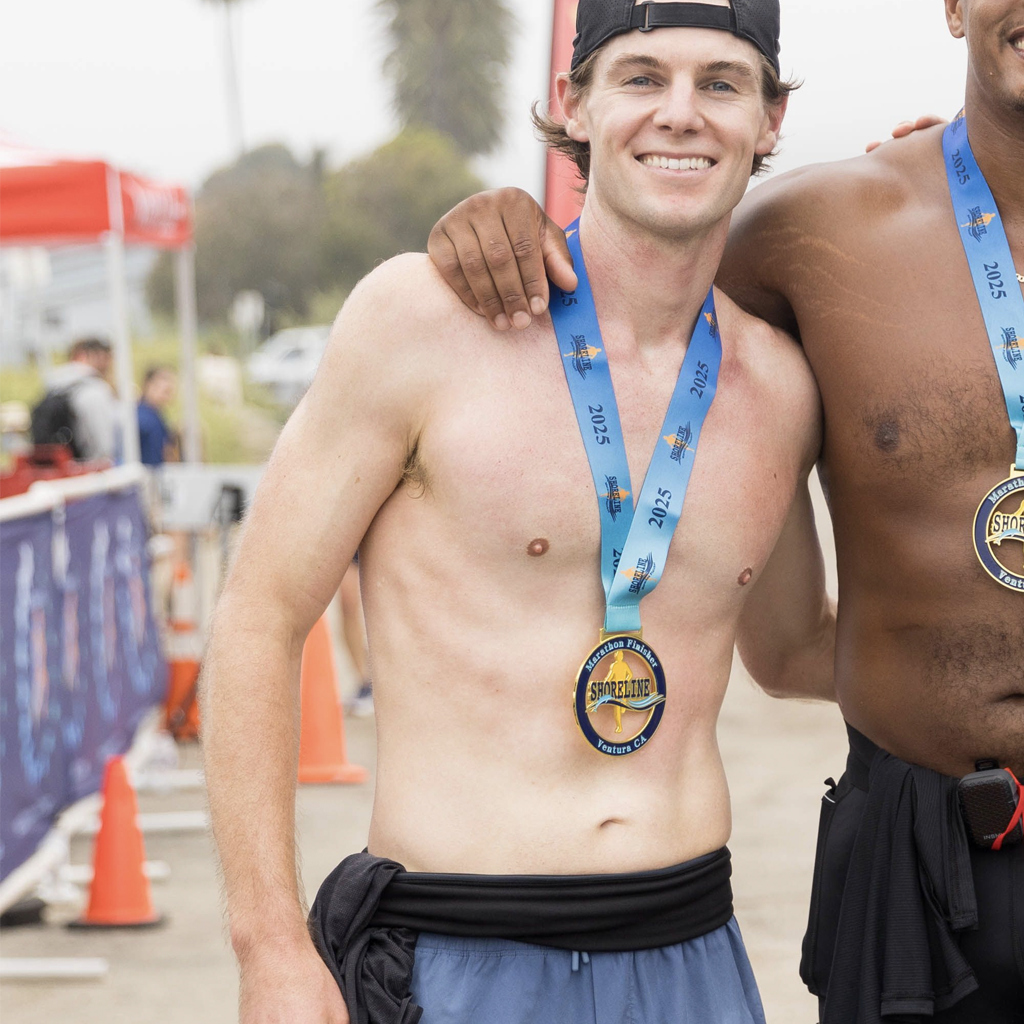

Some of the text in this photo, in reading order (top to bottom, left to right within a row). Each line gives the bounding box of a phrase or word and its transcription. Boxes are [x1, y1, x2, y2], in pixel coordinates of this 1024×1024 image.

[951, 149, 971, 185] 2025
[983, 261, 1007, 300] 2025
[689, 360, 709, 399] 2025
[587, 404, 611, 446] 2025
[648, 487, 672, 529] 2025
[584, 639, 658, 672] Marathon Finisher
[590, 678, 650, 701] SHORELINE
[597, 735, 647, 754] Ventura CA
